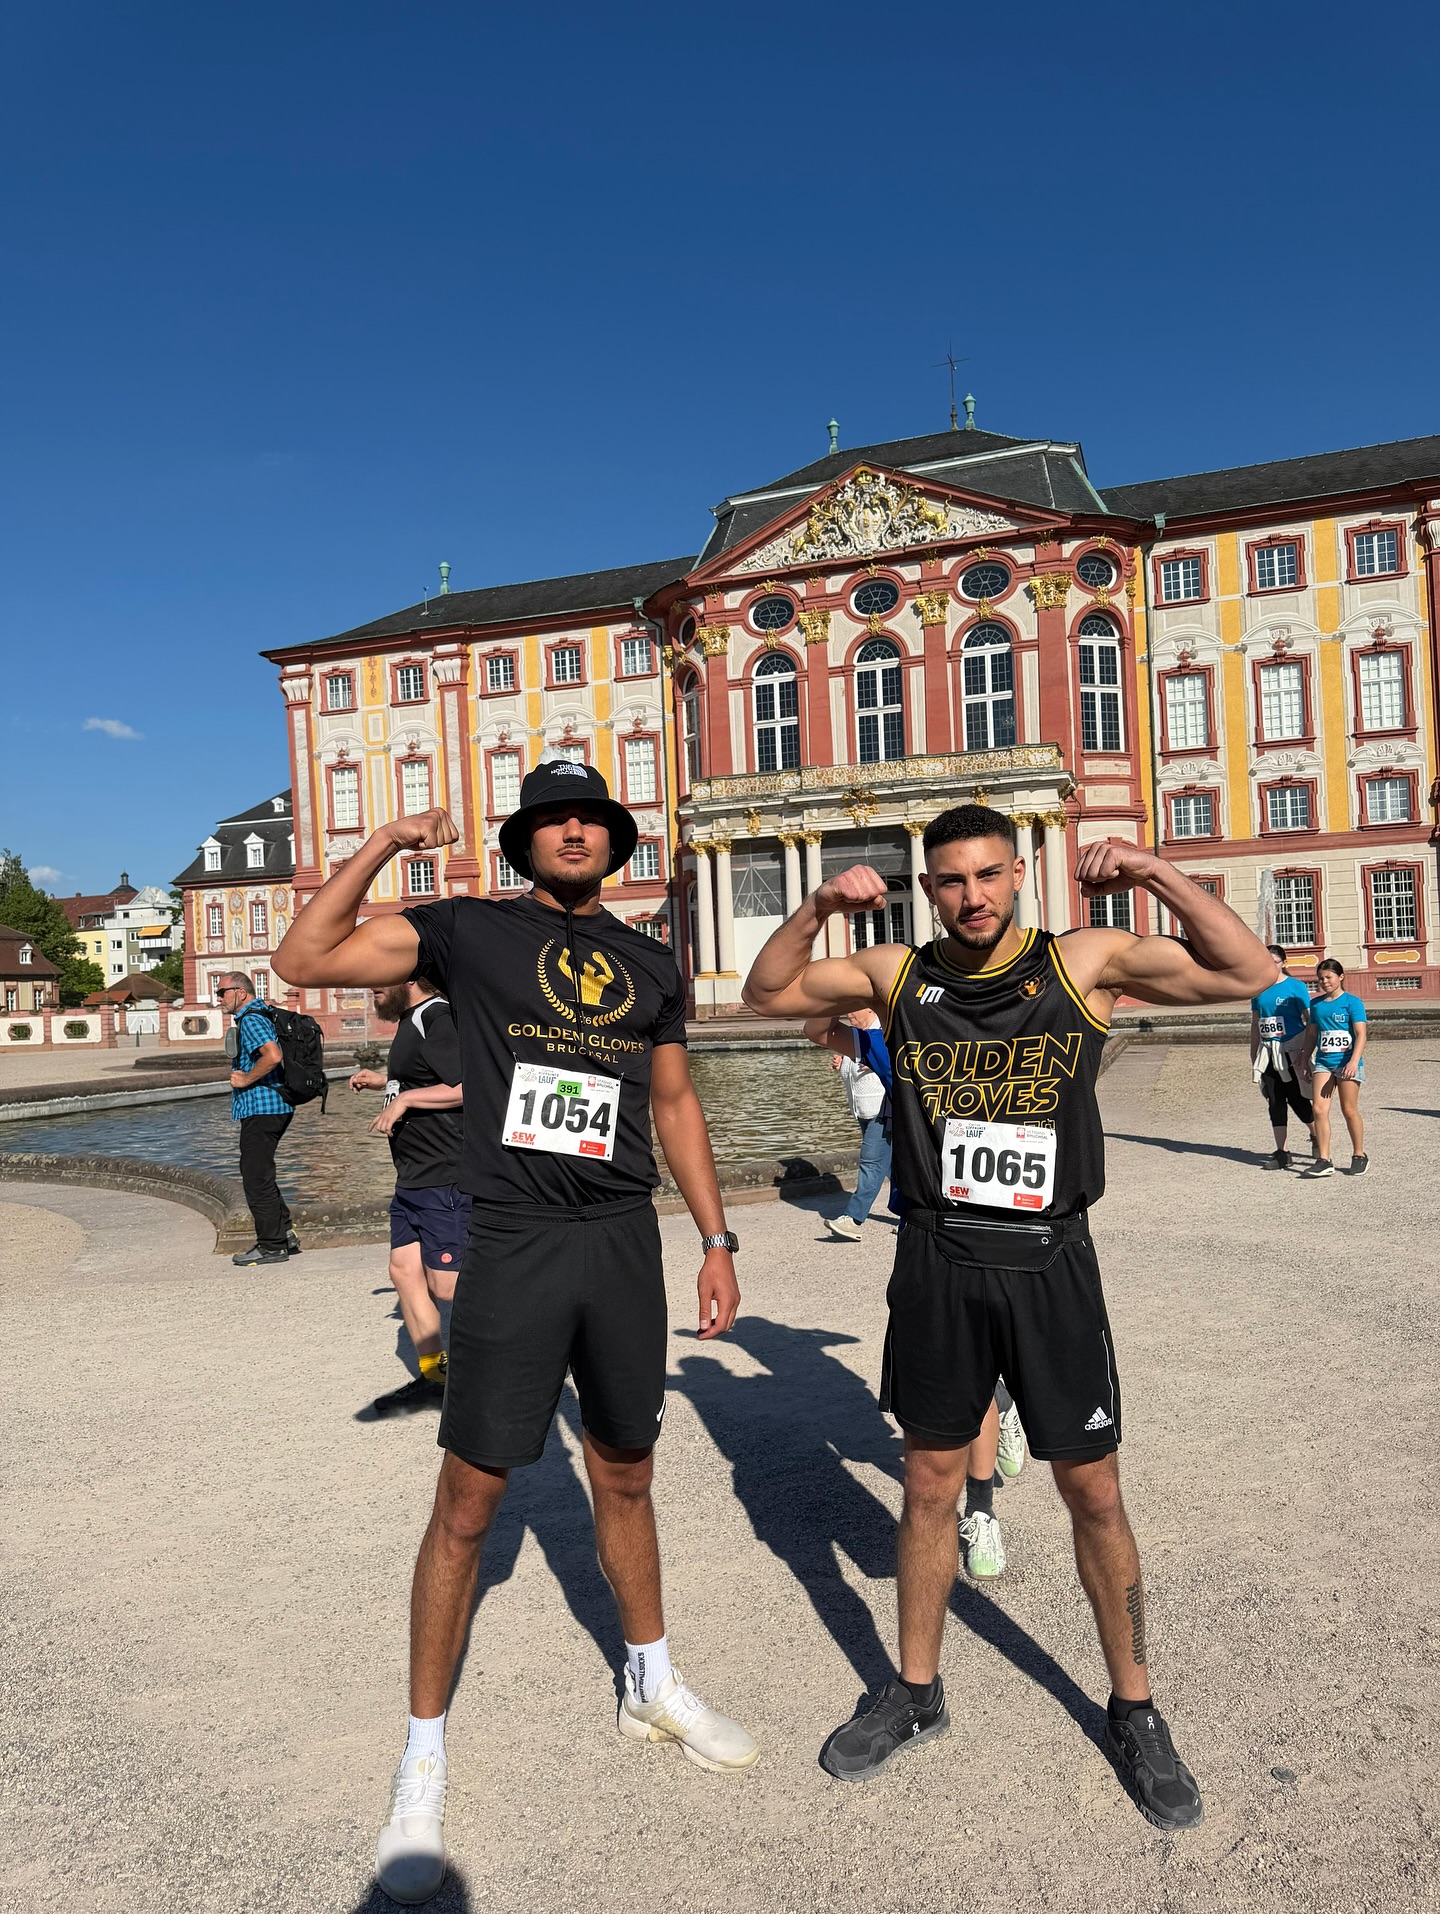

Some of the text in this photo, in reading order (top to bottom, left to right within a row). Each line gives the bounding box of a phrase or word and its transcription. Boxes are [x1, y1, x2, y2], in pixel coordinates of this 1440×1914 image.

[1259, 1022, 1283, 1033] 2686
[508, 1023, 645, 1054] GOLDEN GLOVES
[1321, 1036, 1350, 1047] 2435
[538, 1075, 557, 1085] LAUF
[896, 1032, 1083, 1125] GOLDEN GLOVES
[559, 1084, 580, 1095] 391
[519, 1089, 611, 1137] 1054
[511, 1131, 536, 1142] SEW
[966, 1129, 984, 1138] LAUF
[950, 1144, 1046, 1189] 1065
[949, 1185, 969, 1196] SEW
[1084, 1417, 1113, 1431] adidas
